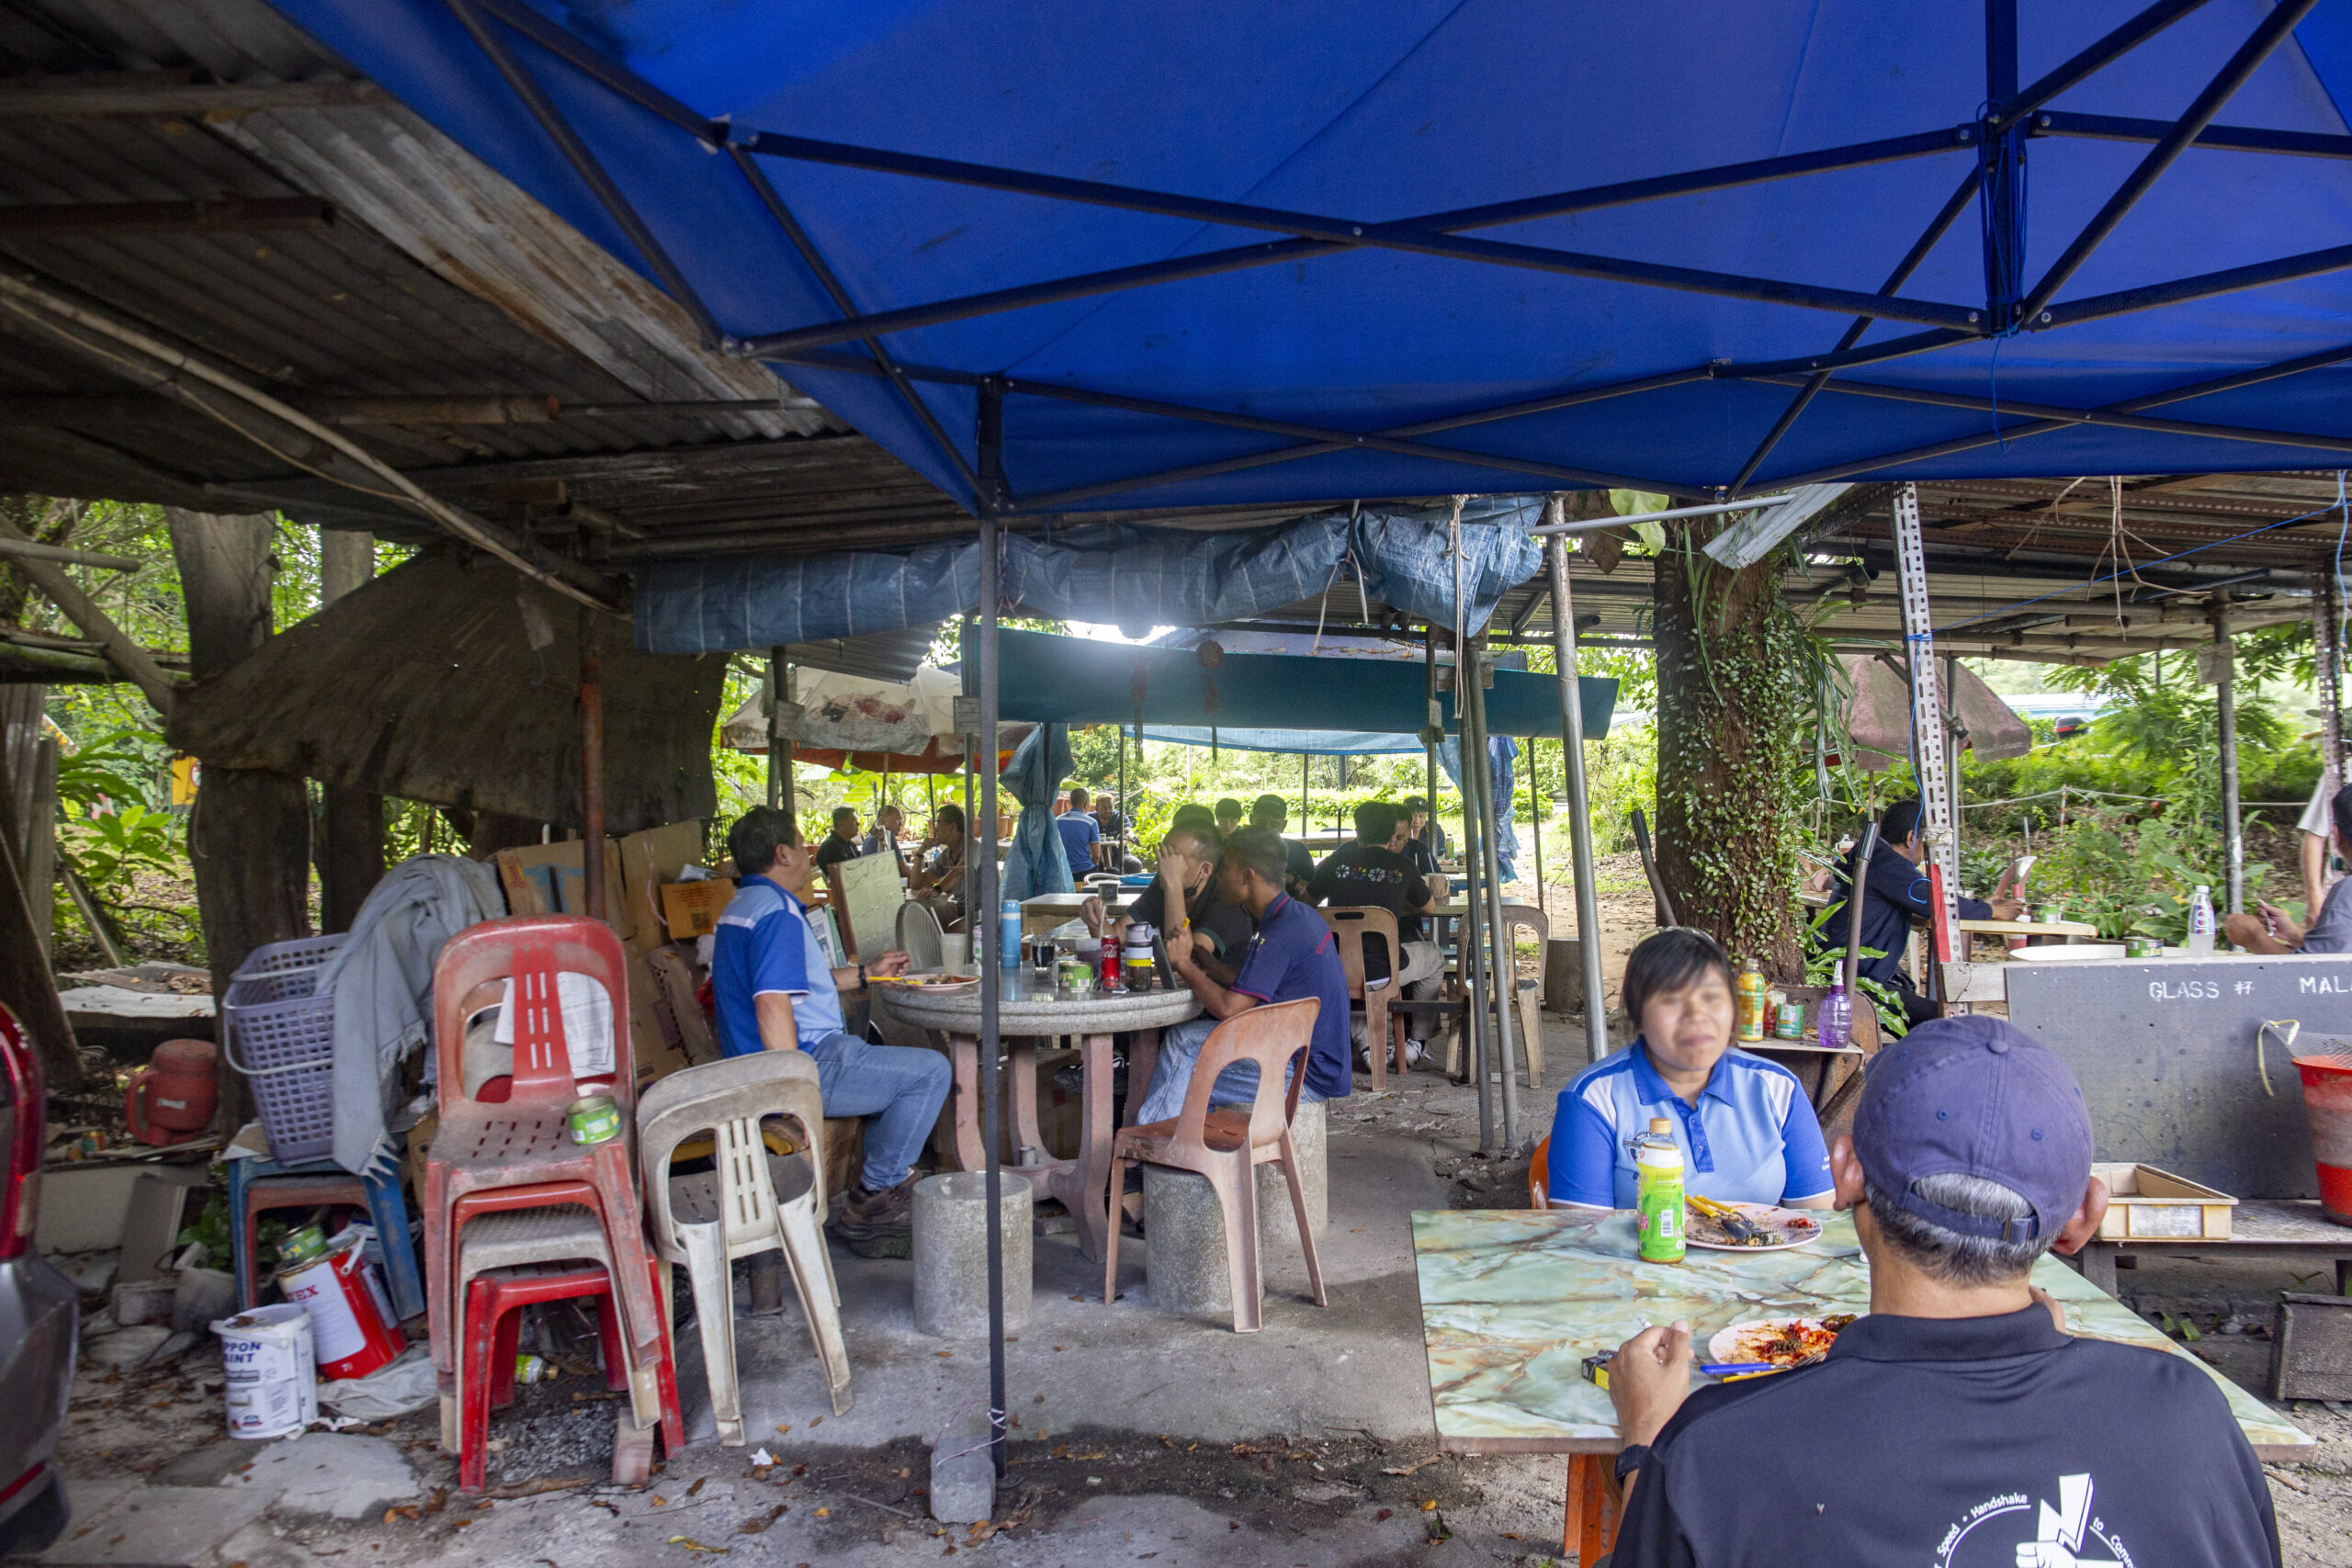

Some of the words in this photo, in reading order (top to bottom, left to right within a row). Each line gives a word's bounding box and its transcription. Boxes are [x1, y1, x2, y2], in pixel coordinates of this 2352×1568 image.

[2148, 980, 2220, 1002] GLASS
[1936, 1522, 1962, 1558] Speed
[1970, 1492, 2028, 1519] Handshake
[2092, 1517, 2105, 1532] to
[2110, 1535, 2137, 1568] Comm
